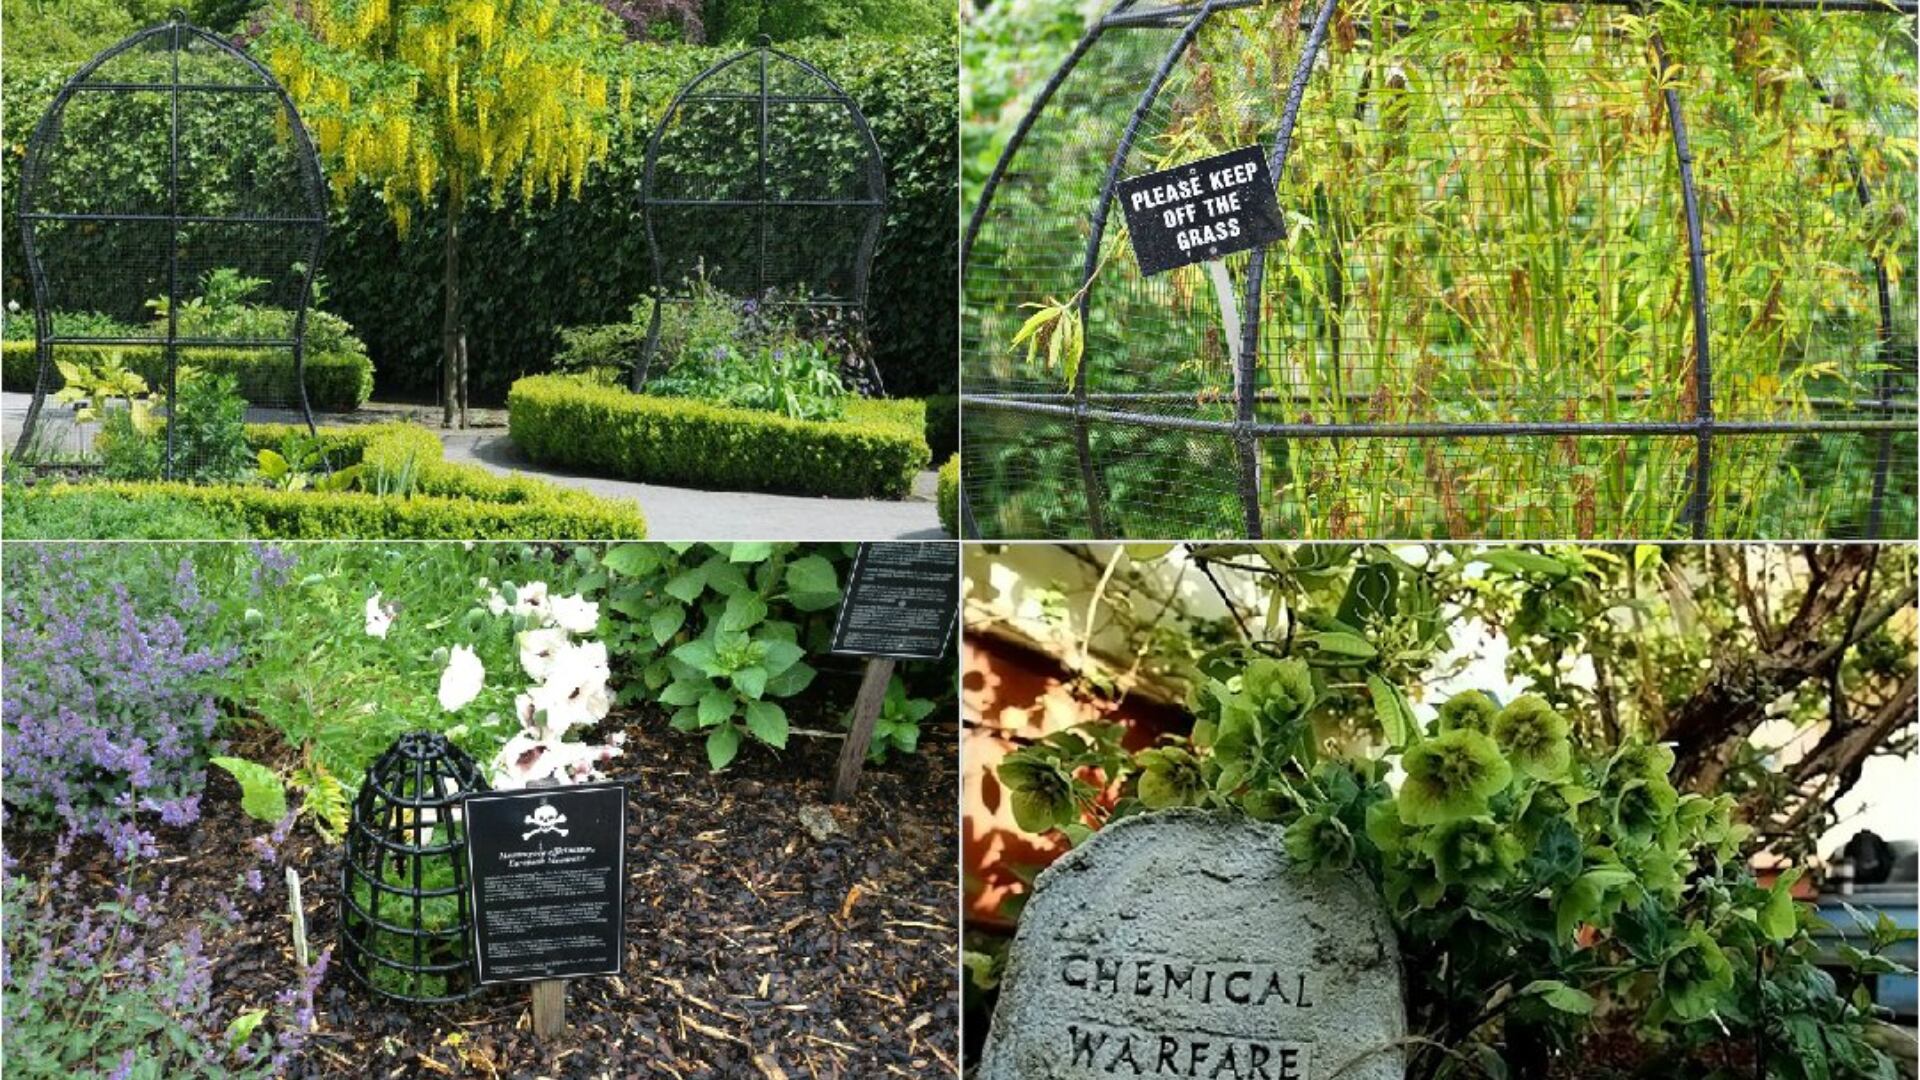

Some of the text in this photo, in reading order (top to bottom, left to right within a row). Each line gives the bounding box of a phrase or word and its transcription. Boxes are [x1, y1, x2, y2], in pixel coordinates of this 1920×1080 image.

[1131, 162, 1258, 212] PLEASE KEEP
[1163, 191, 1242, 229] OFF THE
[1176, 218, 1241, 251] GRASS
[1061, 953, 1314, 1008] CHEMICAL
[1067, 1026, 1300, 1080] WARFARE
